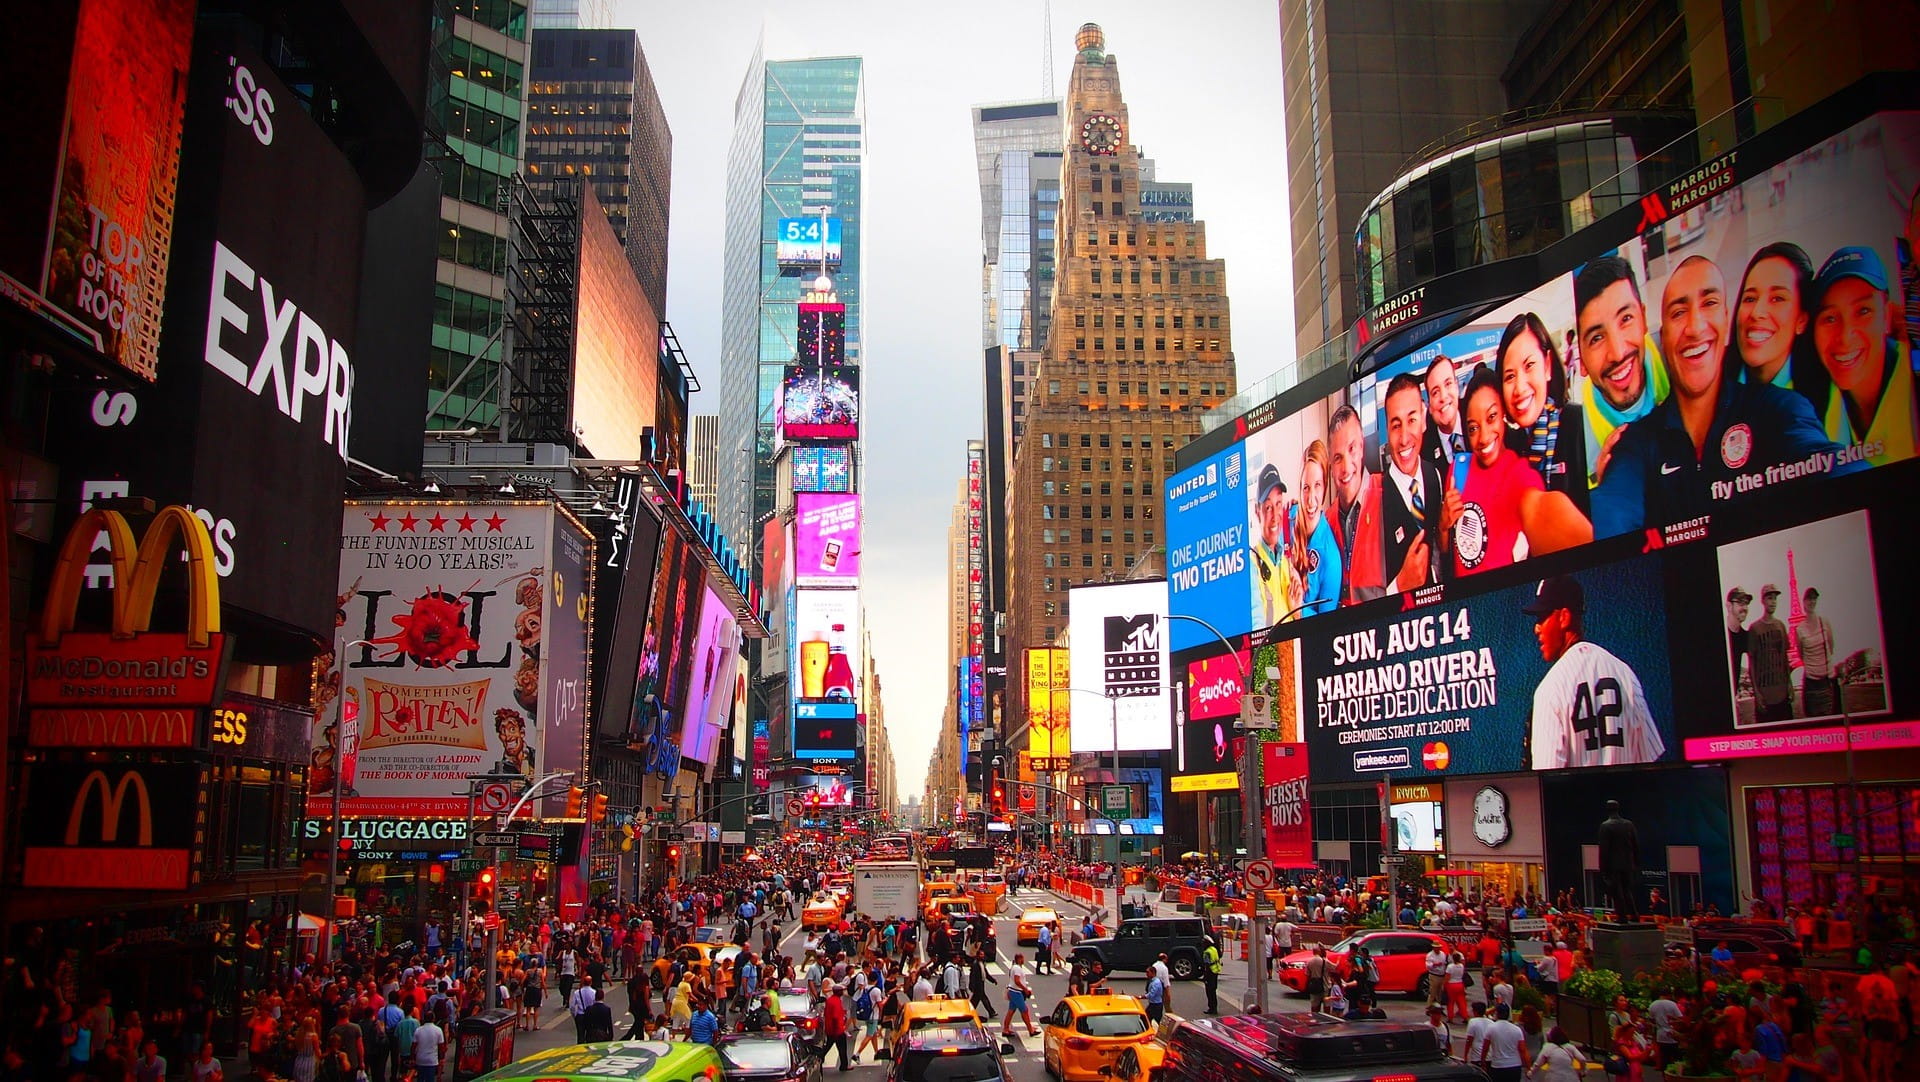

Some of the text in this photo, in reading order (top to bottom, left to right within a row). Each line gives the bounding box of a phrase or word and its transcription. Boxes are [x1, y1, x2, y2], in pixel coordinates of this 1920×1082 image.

[1670, 151, 1739, 196] MARRIOTT
[1671, 171, 1732, 211] MARQUIS
[88, 204, 144, 275] TOP
[81, 252, 106, 282] OF
[78, 277, 142, 338] ROCK
[806, 292, 837, 303] 2016
[1371, 287, 1426, 321] MARRIOTT
[1372, 305, 1420, 335] MARQUIS
[1410, 347, 1435, 365] UNITED
[1248, 400, 1277, 421] MARRIOTT
[1248, 411, 1275, 432] MARQUIS
[514, 472, 553, 485] LAMAR
[1711, 436, 1885, 500] fly the friendly skies
[1169, 474, 1205, 500] UNITED
[1664, 515, 1711, 534] MARRIOTT
[340, 535, 535, 550] THE FUNNIEST MUSICAL
[1172, 523, 1244, 569] ONE JOURNEY
[1665, 528, 1707, 544] MARQUIS
[366, 552, 390, 569] IN
[394, 554, 432, 570] 400
[1172, 548, 1245, 594] TWO TEAMS
[1415, 585, 1445, 598] MARRIOTT
[1415, 594, 1442, 606] MARQUIS
[1104, 613, 1160, 653] MTV
[1332, 608, 1471, 666] SUN, AUG 14
[35, 655, 209, 679] McDonald's
[1108, 655, 1157, 664] VIDEO
[1031, 679, 1049, 689] KING
[1032, 670, 1047, 679] LION
[1108, 670, 1157, 680] MUSIC
[1317, 647, 1497, 702] MARIANO RIVERA
[61, 683, 178, 698] Restaurant
[381, 685, 472, 698] SOMETHING
[1199, 677, 1237, 703] swatch
[554, 678, 578, 728] CATS
[798, 706, 817, 717] FX
[1318, 676, 1497, 729] PLAQUE DEDICATION
[365, 687, 485, 741] RTTEN!
[1571, 677, 1624, 752] 42
[1338, 716, 1471, 745] CEREMONIES START AT 12:00 PM
[1710, 743, 1731, 752] STEP
[1762, 738, 1785, 749] SNAP
[1785, 736, 1813, 747] YOUR
[1812, 733, 1845, 746] PHOTO
[1849, 731, 1868, 743] GET
[434, 755, 481, 763] ALADDIN
[1355, 751, 1408, 769] yankees.com
[360, 771, 479, 779] THE BOOK OF MORM
[1265, 779, 1309, 807] JERSEY
[1396, 786, 1431, 801] INVICTA
[1272, 802, 1303, 827] BOYS
[341, 820, 467, 840] LUGGAGE
[485, 835, 500, 844] ONE
[352, 839, 376, 850] NY
[358, 851, 394, 860] SONY
[460, 862, 481, 871] W 46
